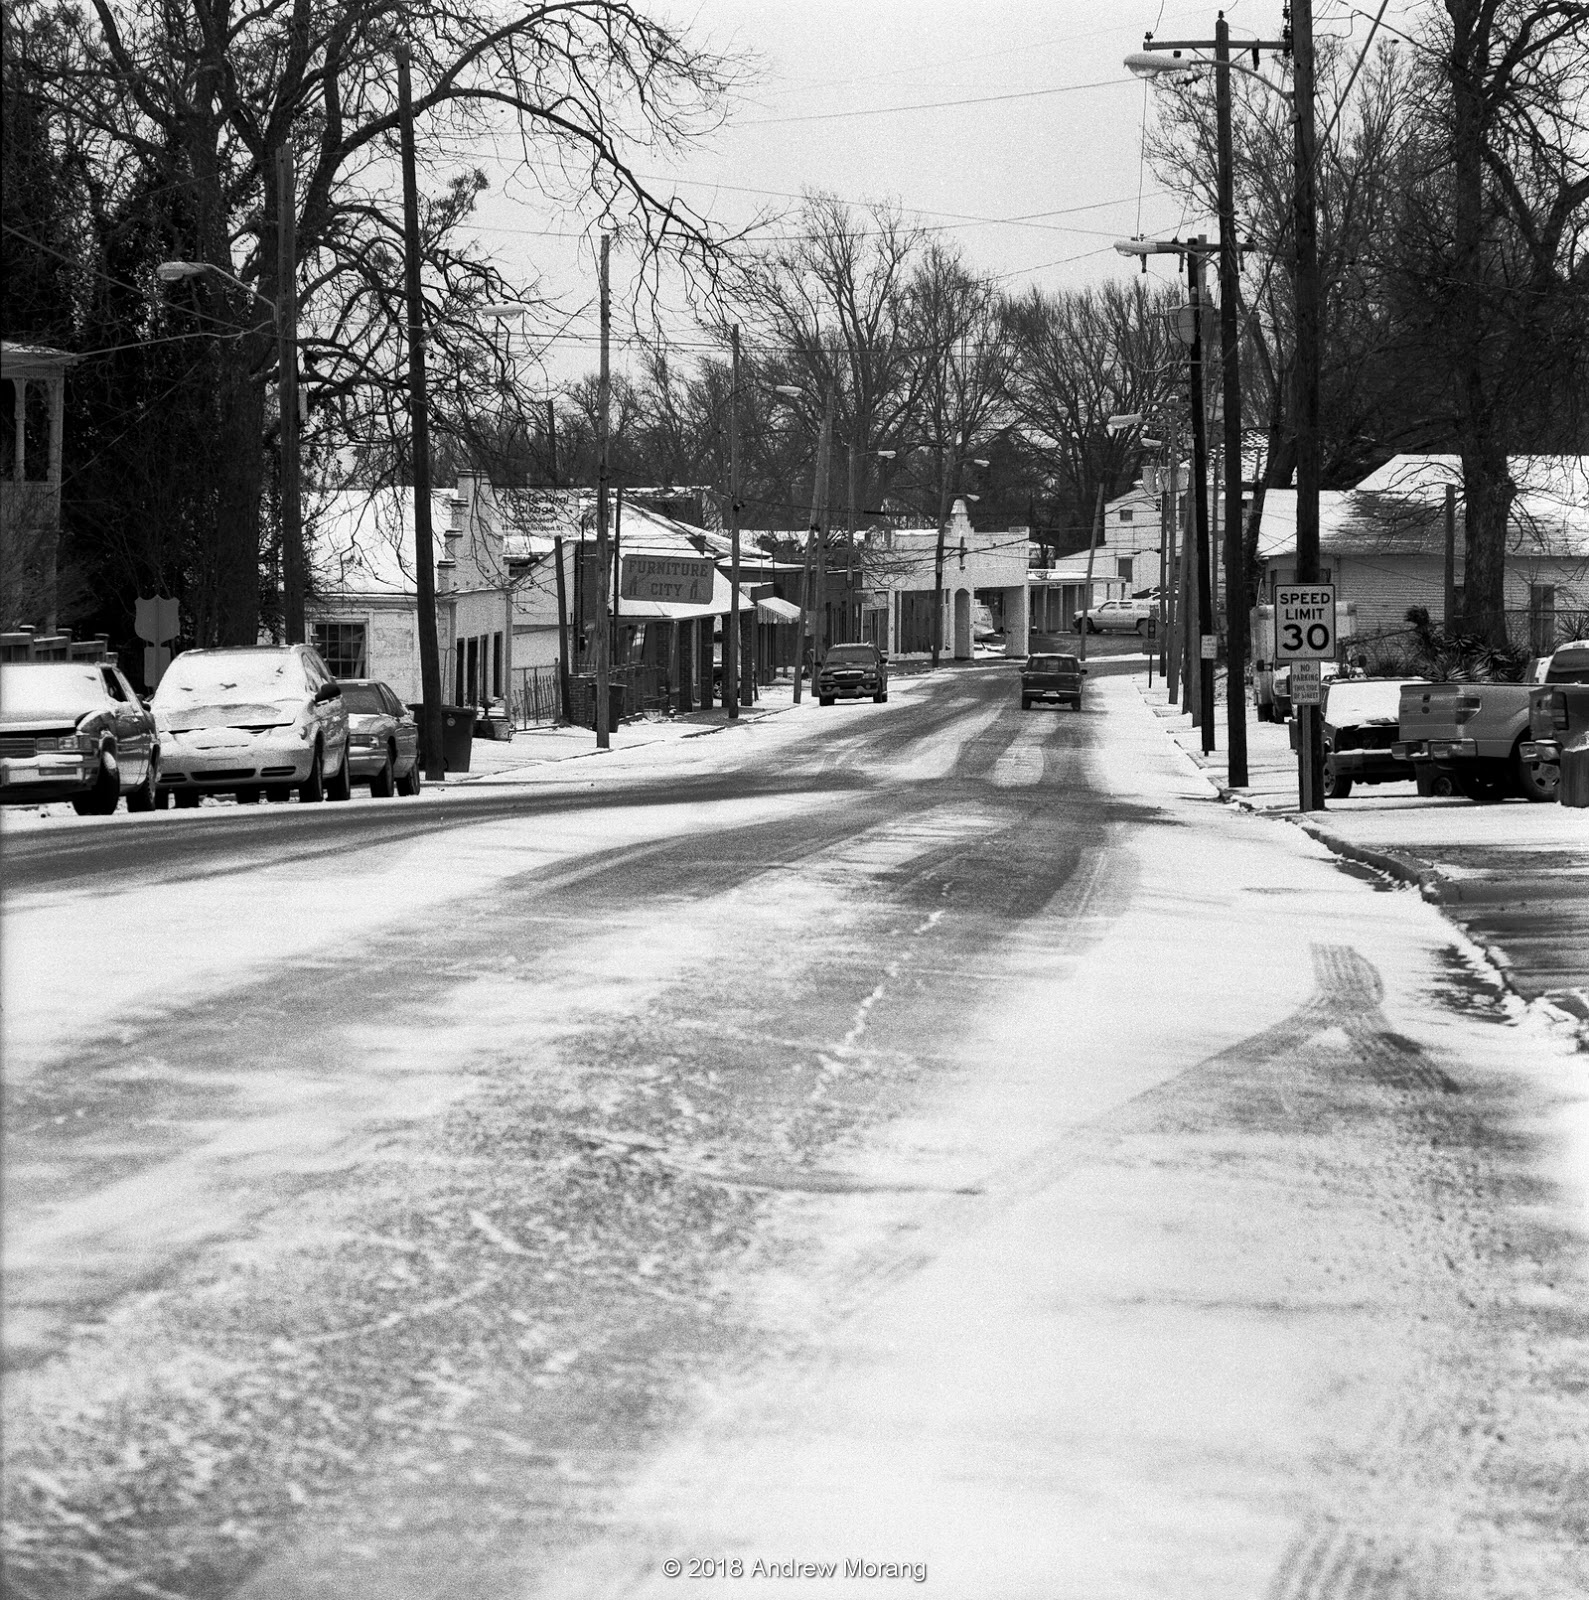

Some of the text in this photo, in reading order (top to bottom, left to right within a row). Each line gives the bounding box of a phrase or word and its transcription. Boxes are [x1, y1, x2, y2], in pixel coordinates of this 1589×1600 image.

[628, 561, 708, 577] FURNITURE
[651, 583, 683, 596] CITY
[1280, 593, 1330, 605] SPEED
[1286, 608, 1325, 620] LIMIT
[1282, 624, 1330, 651] 30
[1300, 664, 1310, 672] NO
[1292, 673, 1319, 681] PARKING
